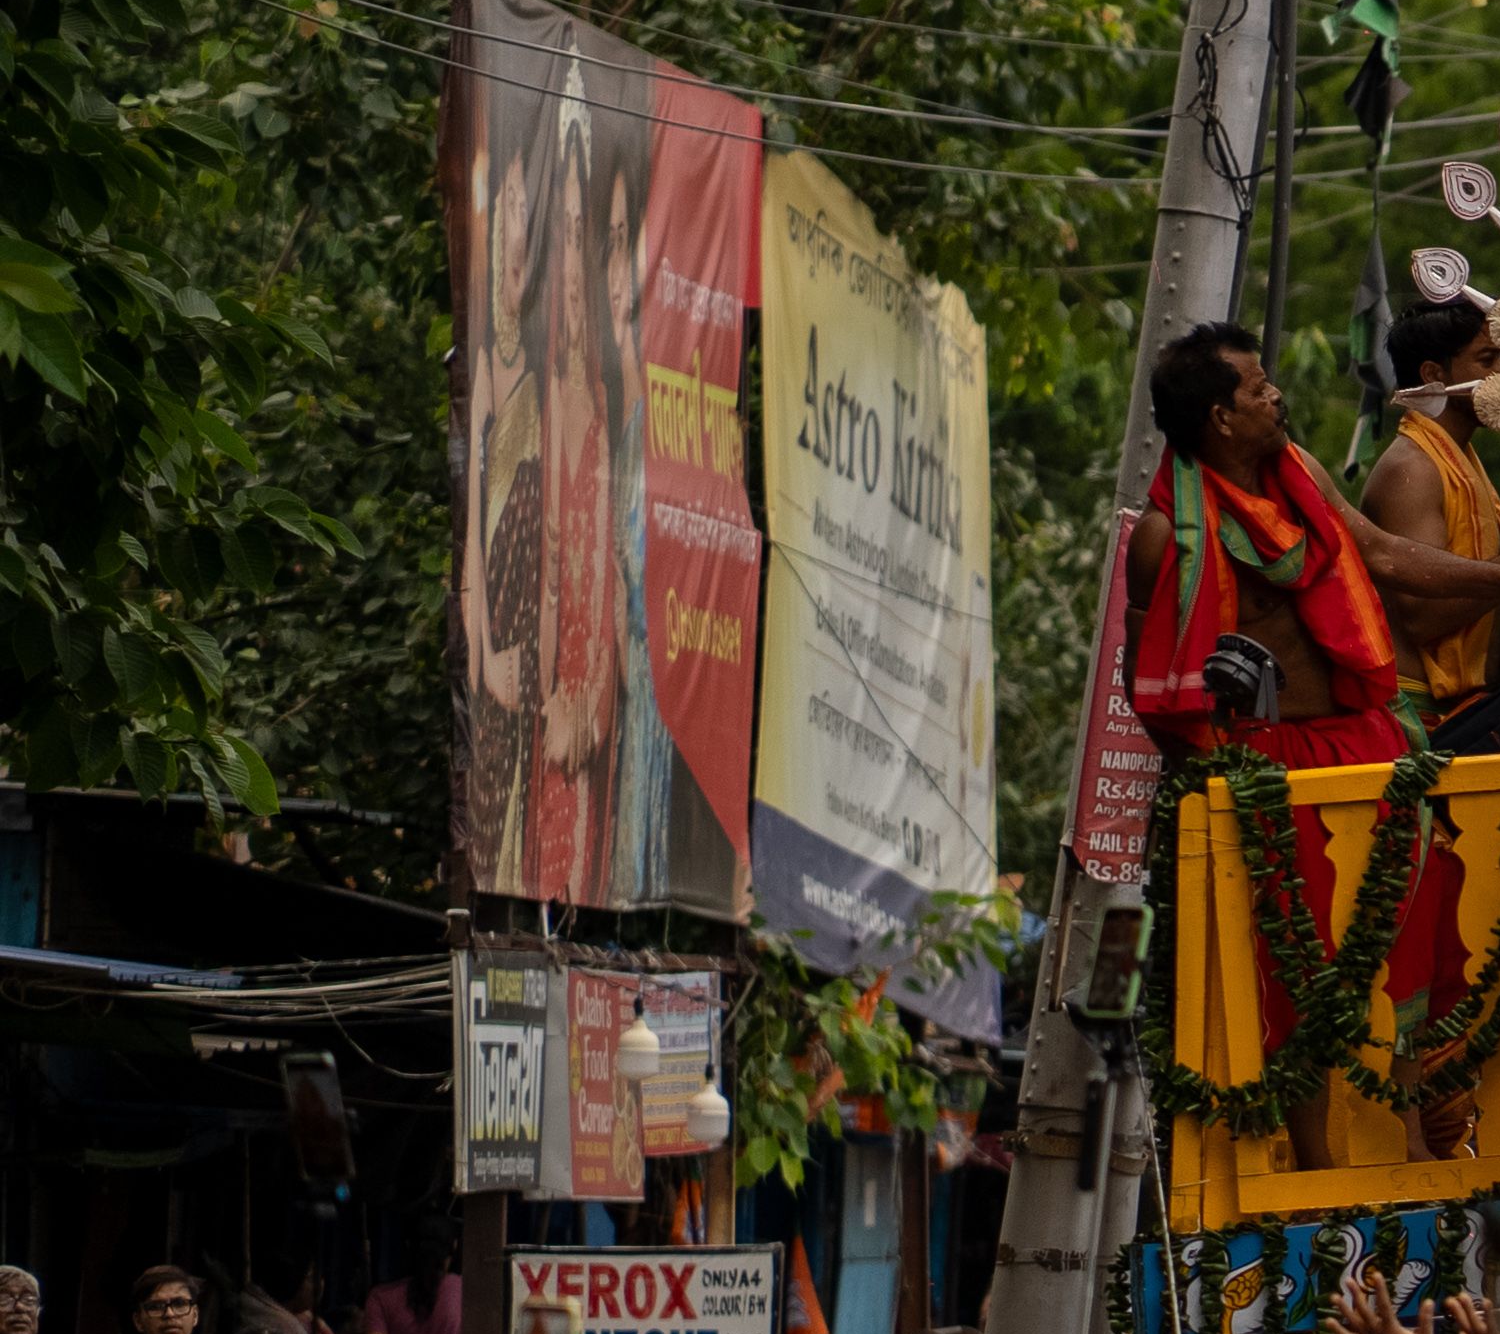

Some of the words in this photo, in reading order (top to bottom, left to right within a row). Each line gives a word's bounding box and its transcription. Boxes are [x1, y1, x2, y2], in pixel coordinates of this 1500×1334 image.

[797, 323, 881, 495] Astro
[1094, 802, 1118, 818] Any
[1089, 831, 1123, 853] NAIL
[583, 1033, 609, 1082] Food
[578, 1089, 614, 1134] Corner
[518, 1261, 698, 1319] XEROX
[702, 1268, 736, 1287] ONLY
